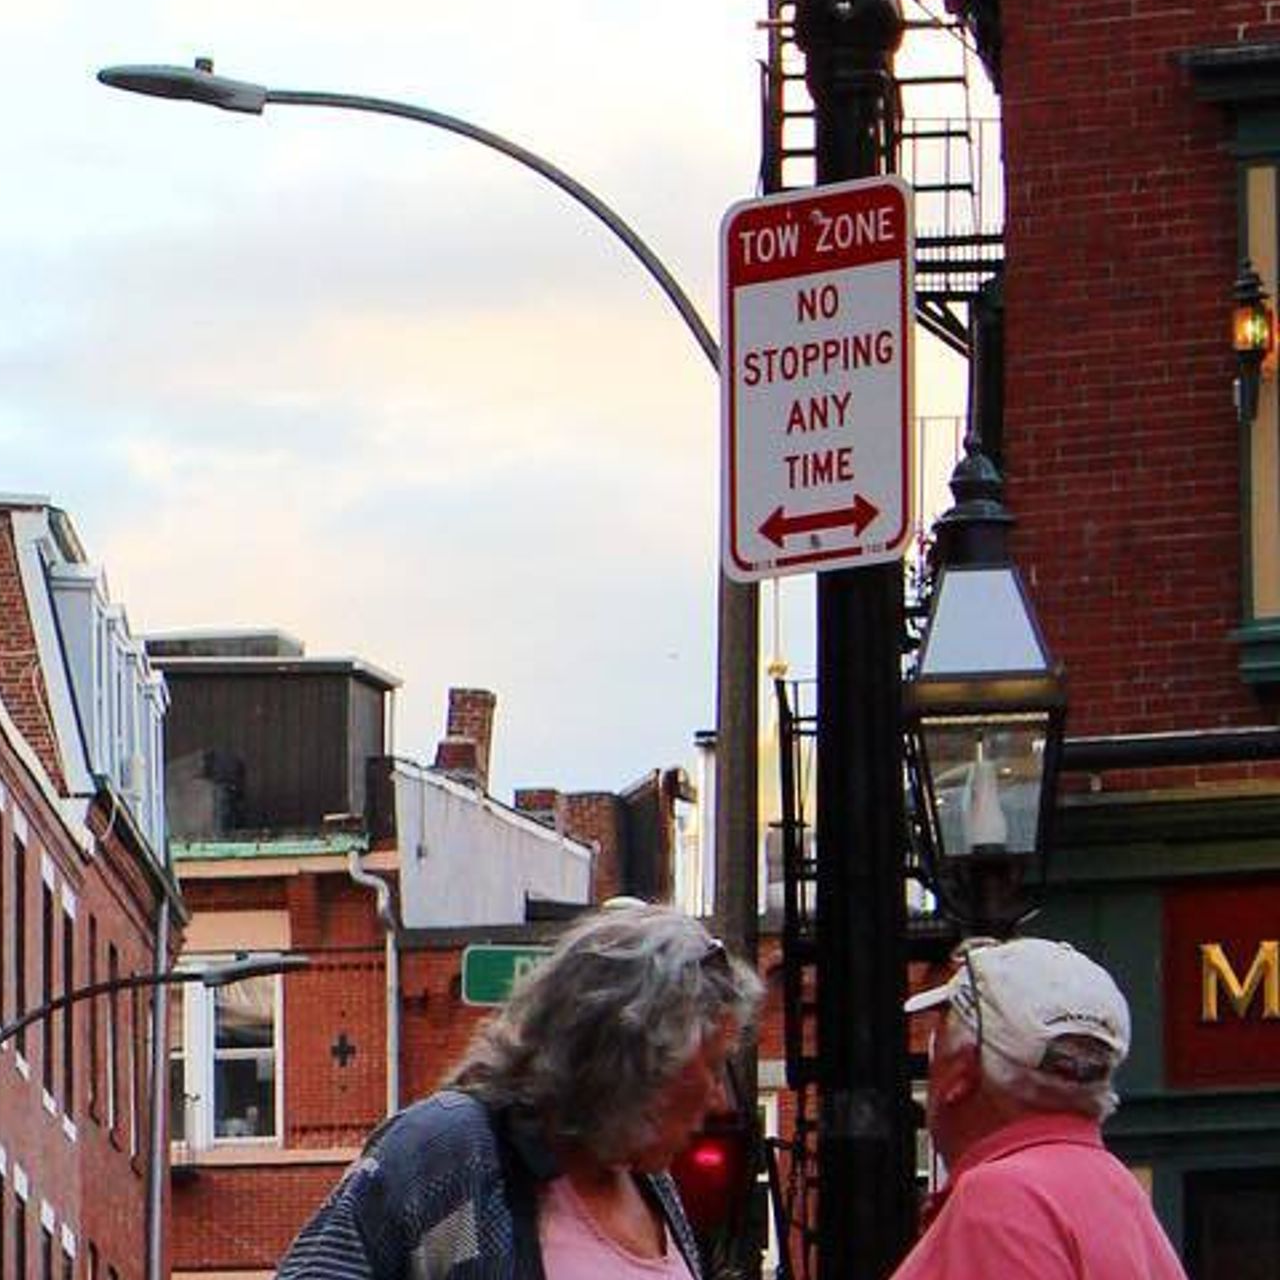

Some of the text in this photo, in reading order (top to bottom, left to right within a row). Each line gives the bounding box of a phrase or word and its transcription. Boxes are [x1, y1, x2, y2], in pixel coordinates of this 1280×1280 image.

[740, 207, 895, 265] TOW ZONE
[797, 284, 839, 322] NO
[743, 331, 893, 386] STOPPING
[786, 393, 852, 435] ANY
[784, 448, 853, 490] TIME
